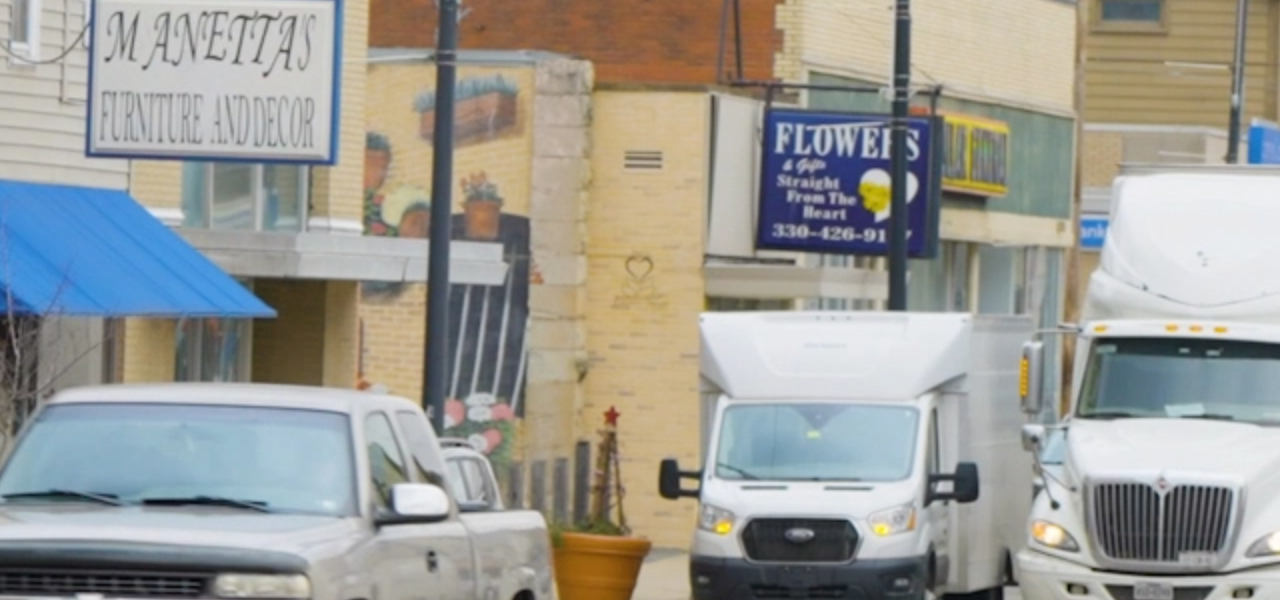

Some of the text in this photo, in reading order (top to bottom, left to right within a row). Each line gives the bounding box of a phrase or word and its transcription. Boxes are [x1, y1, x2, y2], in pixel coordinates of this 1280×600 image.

[104, 10, 316, 78] MANETTA'S
[99, 90, 315, 148] FURNITURE AND DECOR
[782, 160, 793, 171] &
[776, 174, 840, 191] Straight
[786, 190, 857, 206] From The
[803, 205, 847, 221] Heart
[773, 223, 913, 243] 330-426-91
